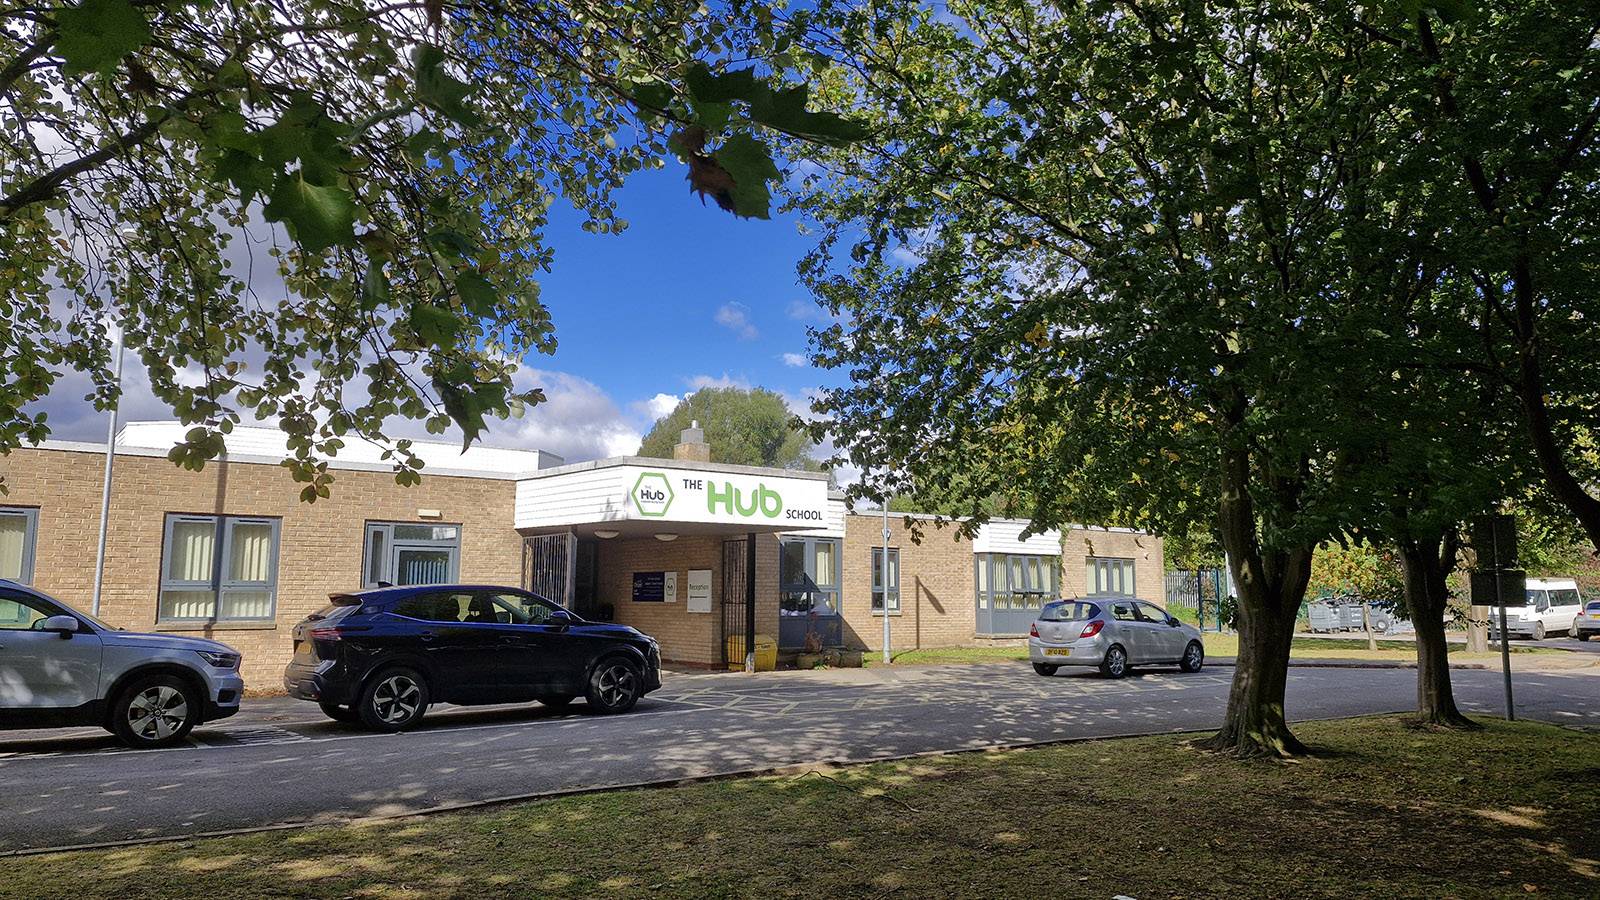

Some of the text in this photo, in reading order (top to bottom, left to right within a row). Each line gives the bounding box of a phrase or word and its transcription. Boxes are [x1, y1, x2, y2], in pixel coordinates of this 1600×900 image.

[640, 489, 665, 501] Hub
[683, 479, 823, 521] THE Hub SCHOOL
